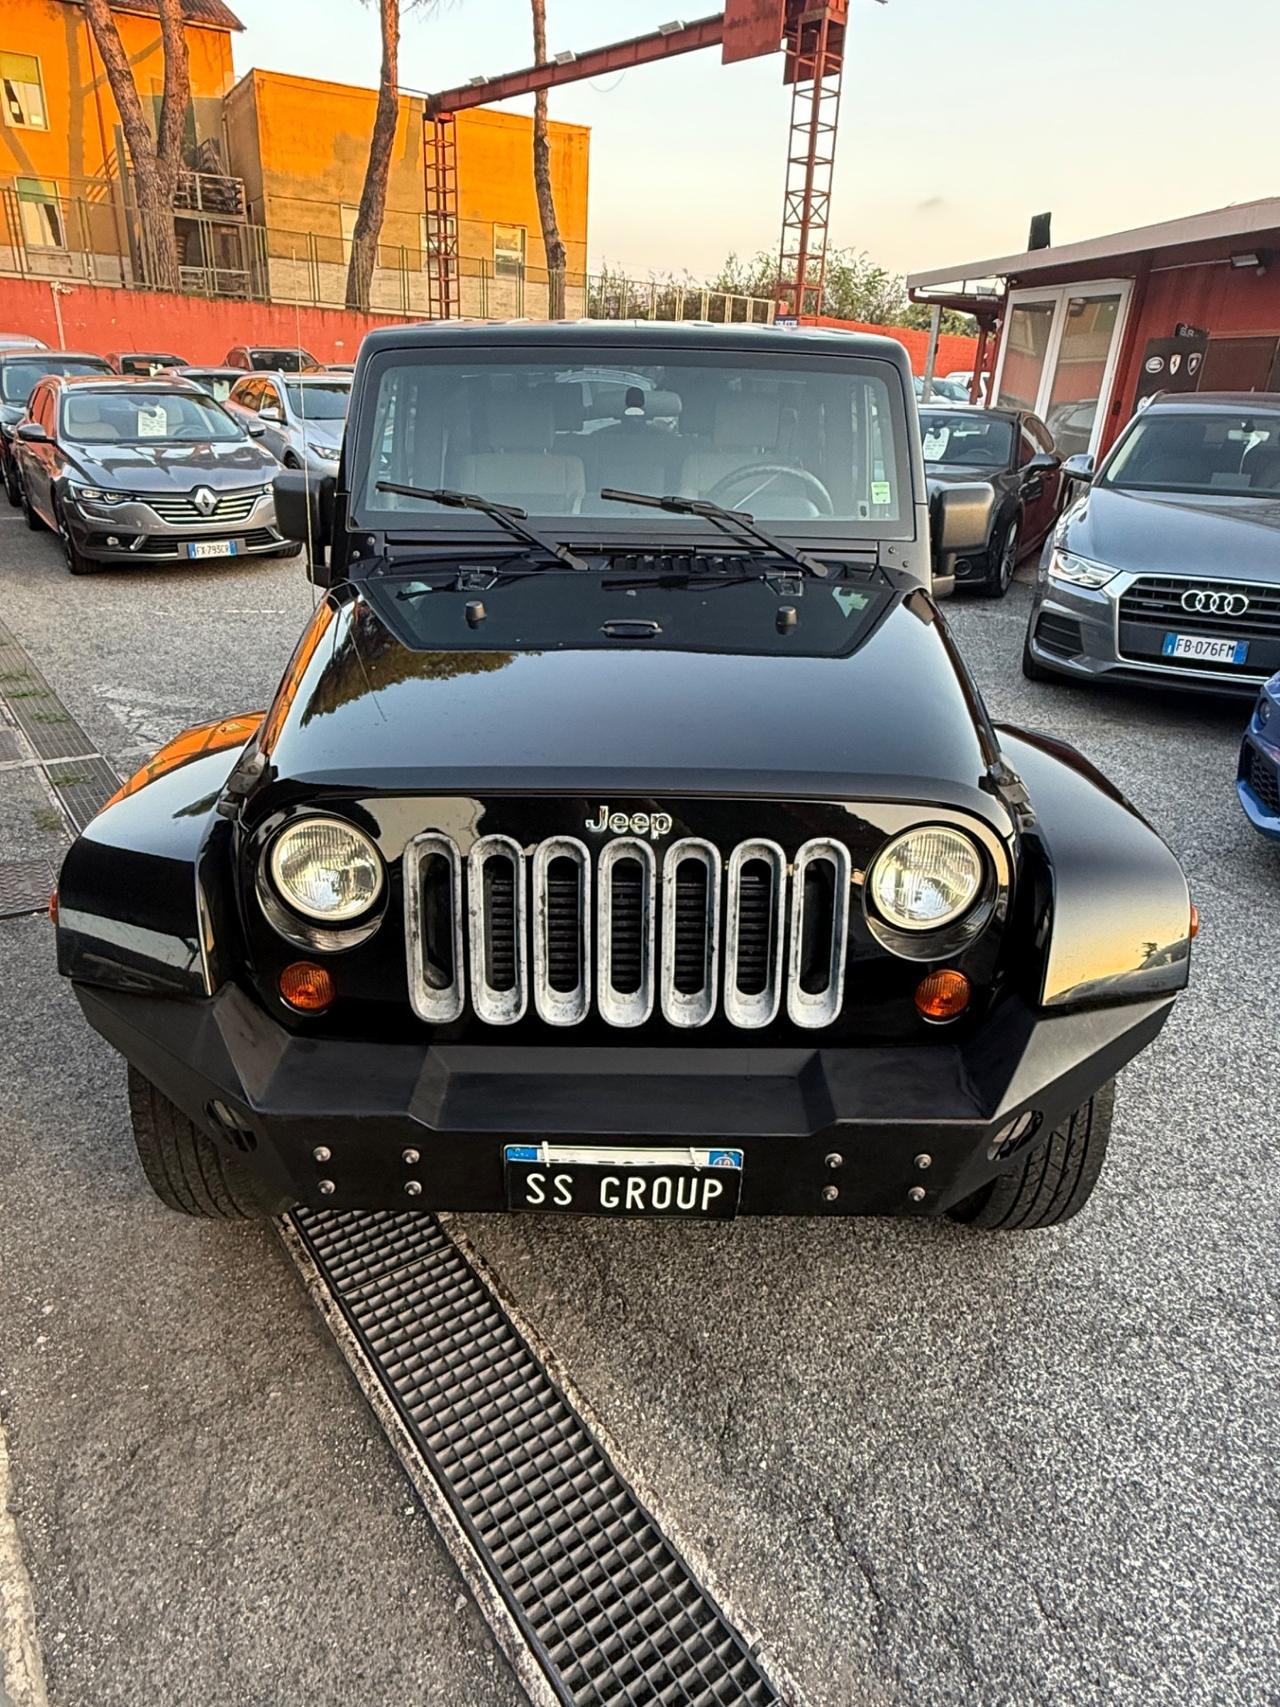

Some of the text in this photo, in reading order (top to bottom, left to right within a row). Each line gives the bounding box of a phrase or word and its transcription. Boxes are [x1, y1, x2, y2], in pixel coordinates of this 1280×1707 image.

[585, 805, 673, 840] Jeep
[526, 1173, 723, 1211] SS GROUP
